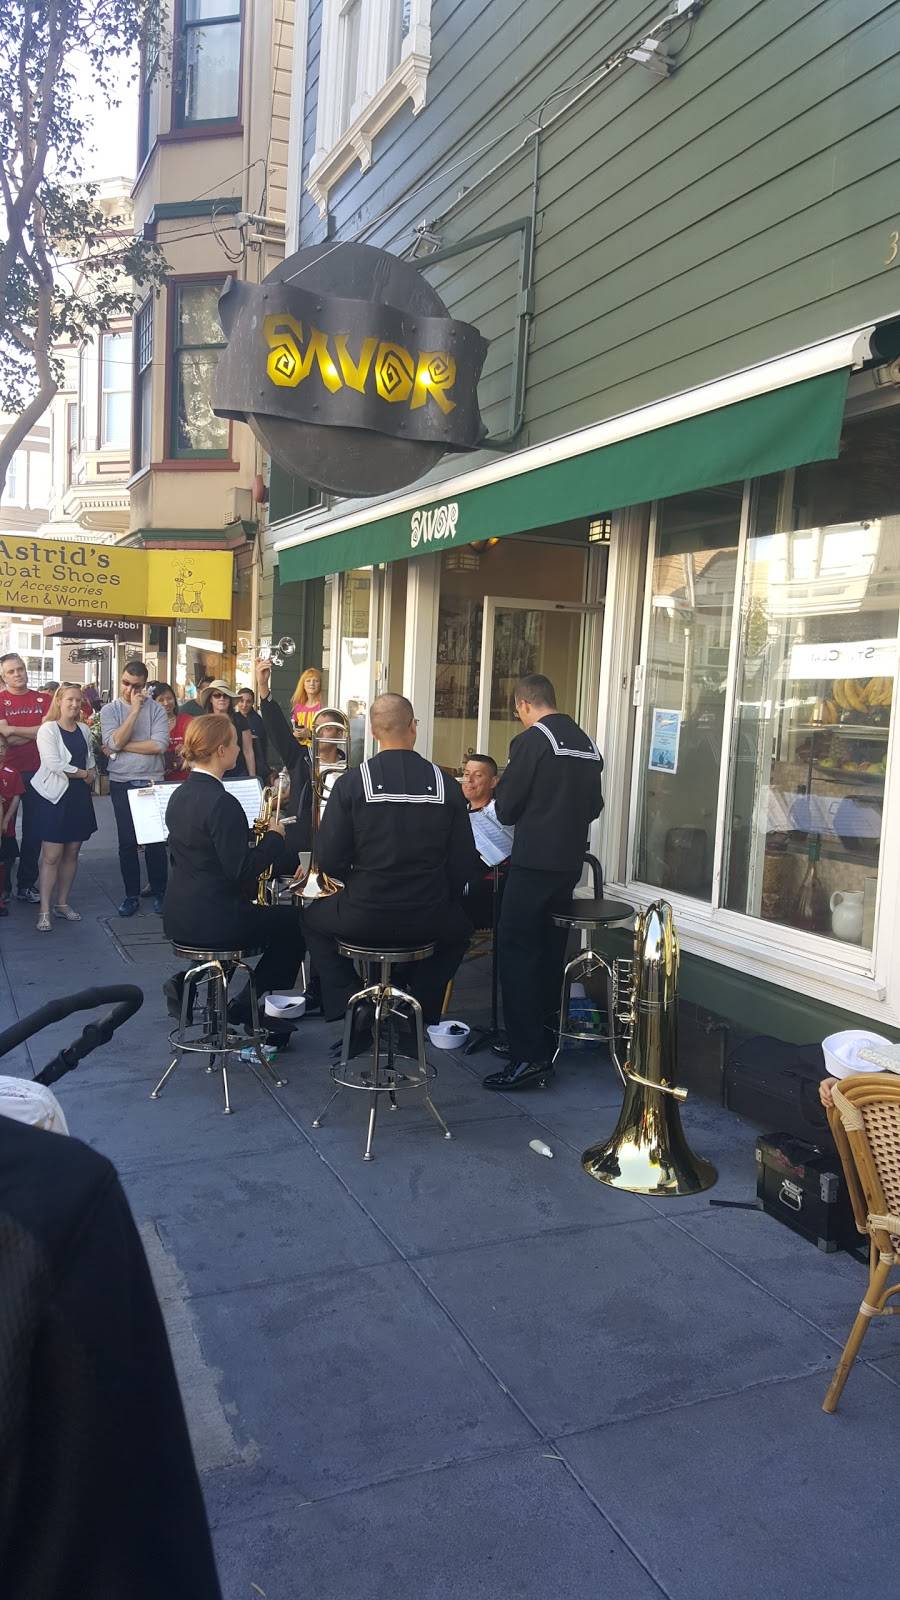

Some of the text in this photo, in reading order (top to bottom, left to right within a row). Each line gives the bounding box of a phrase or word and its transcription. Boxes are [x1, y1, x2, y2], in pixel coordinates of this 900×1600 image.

[263, 313, 457, 415] SAVOR
[411, 502, 459, 548] SAVOR
[0, 561, 121, 586] bat Shoes
[6, 590, 108, 609] Men & Women
[20, 580, 104, 596] Accessories
